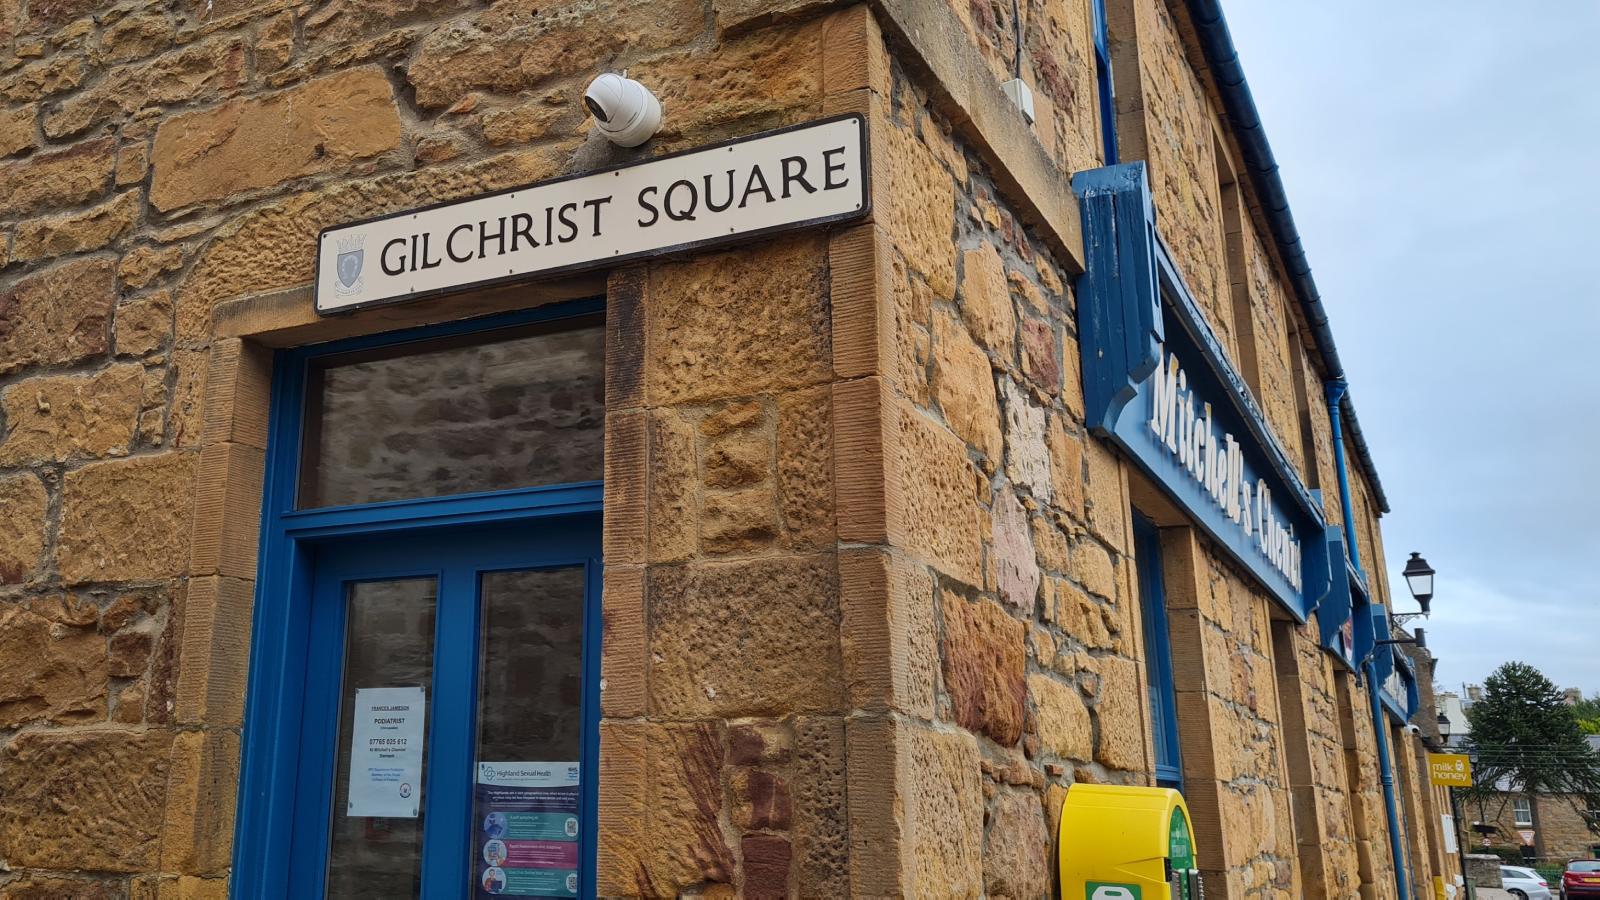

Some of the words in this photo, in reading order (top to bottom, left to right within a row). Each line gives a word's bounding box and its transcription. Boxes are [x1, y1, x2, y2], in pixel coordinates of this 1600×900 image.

[380, 196, 613, 277] GILCHRIST
[637, 146, 850, 229] SQUARE
[1151, 345, 1252, 537] Mitchell's
[1432, 762, 1454, 771] milk
[496, 769, 520, 778] Highland
[520, 769, 536, 777] Sexual
[536, 769, 552, 777] Health
[1433, 770, 1467, 782] honey
